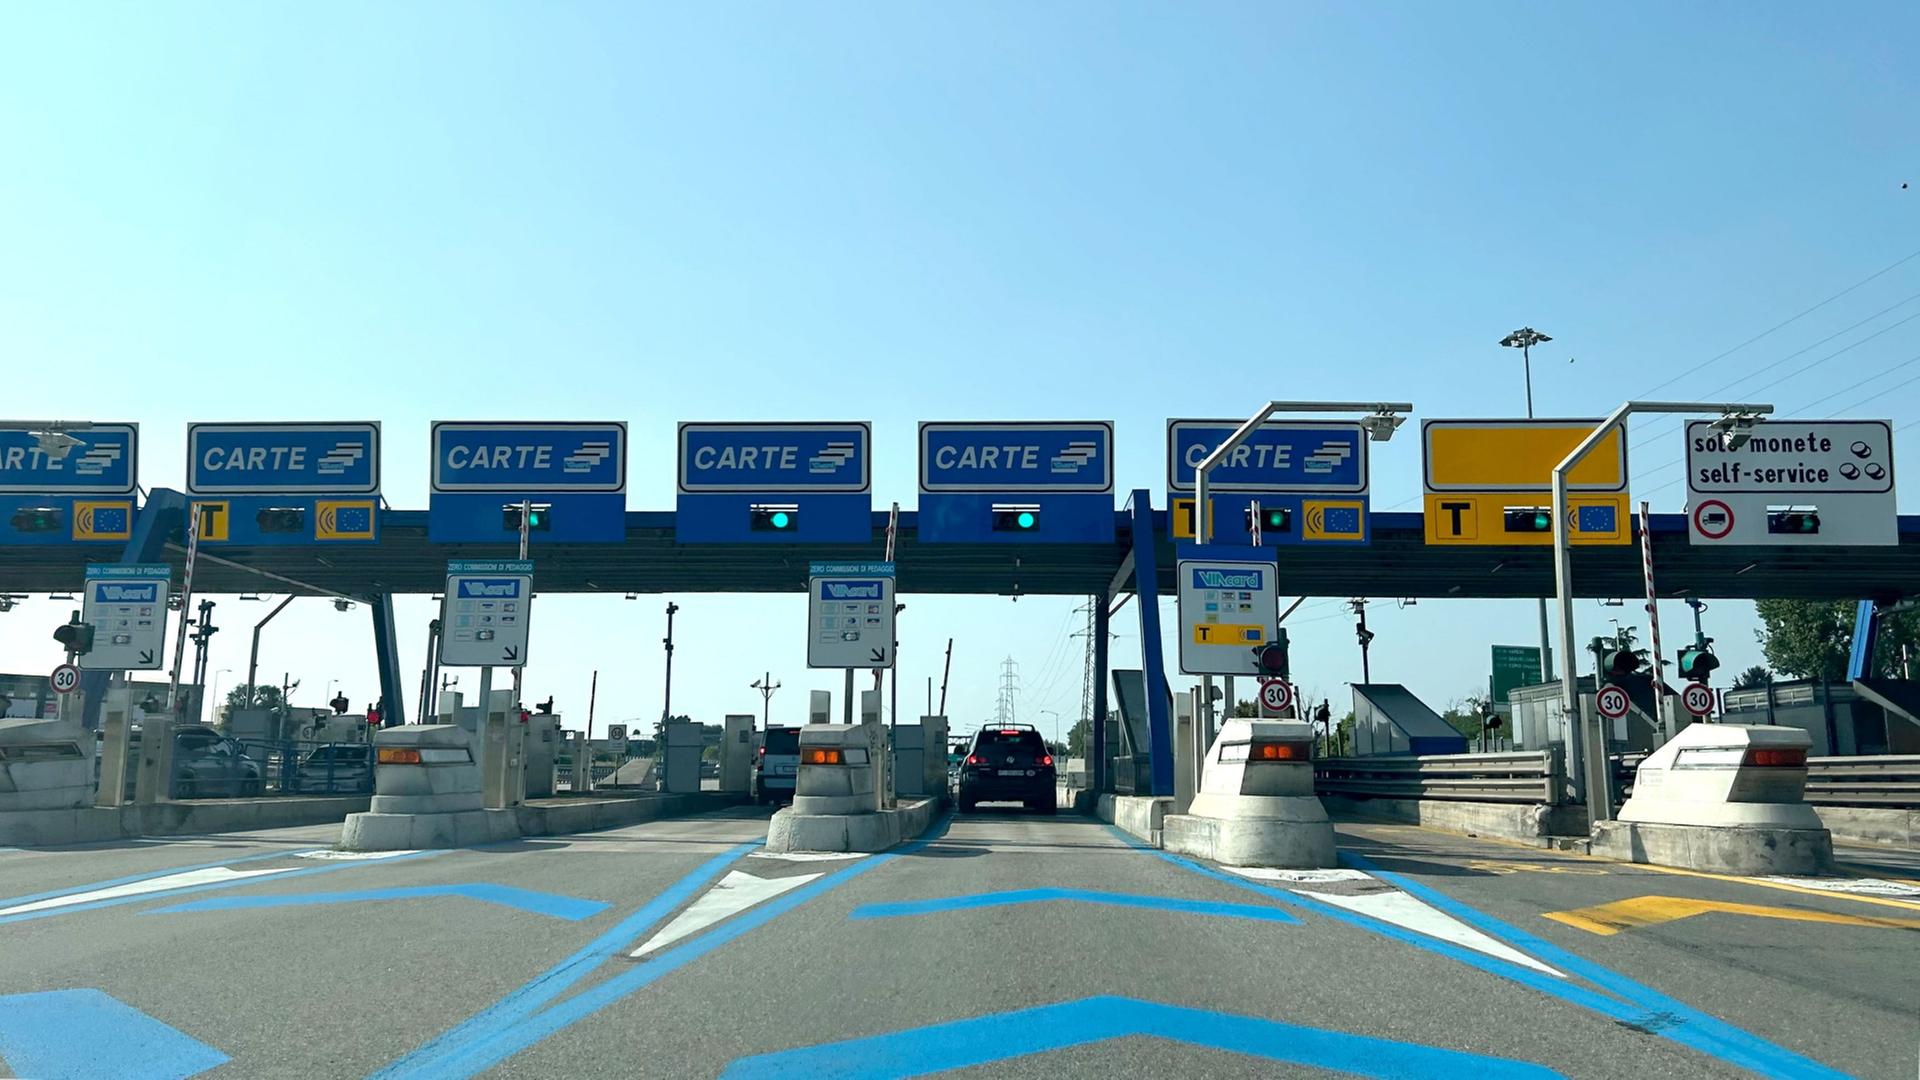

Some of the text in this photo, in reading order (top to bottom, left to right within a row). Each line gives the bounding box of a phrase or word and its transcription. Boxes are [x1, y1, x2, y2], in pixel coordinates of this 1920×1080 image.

[1750, 432, 1832, 453] monete
[203, 447, 307, 471] CARTE
[447, 445, 553, 469] CARTE
[694, 446, 799, 470] CARTE
[935, 445, 1040, 469] CARTE
[1700, 462, 1829, 483] self-service
[200, 505, 223, 536] T
[1441, 502, 1470, 535] T
[1199, 627, 1210, 641] T
[57, 672, 74, 686] 30
[1268, 688, 1285, 703] 30
[1604, 696, 1623, 710] 30
[1690, 692, 1708, 707] 30
